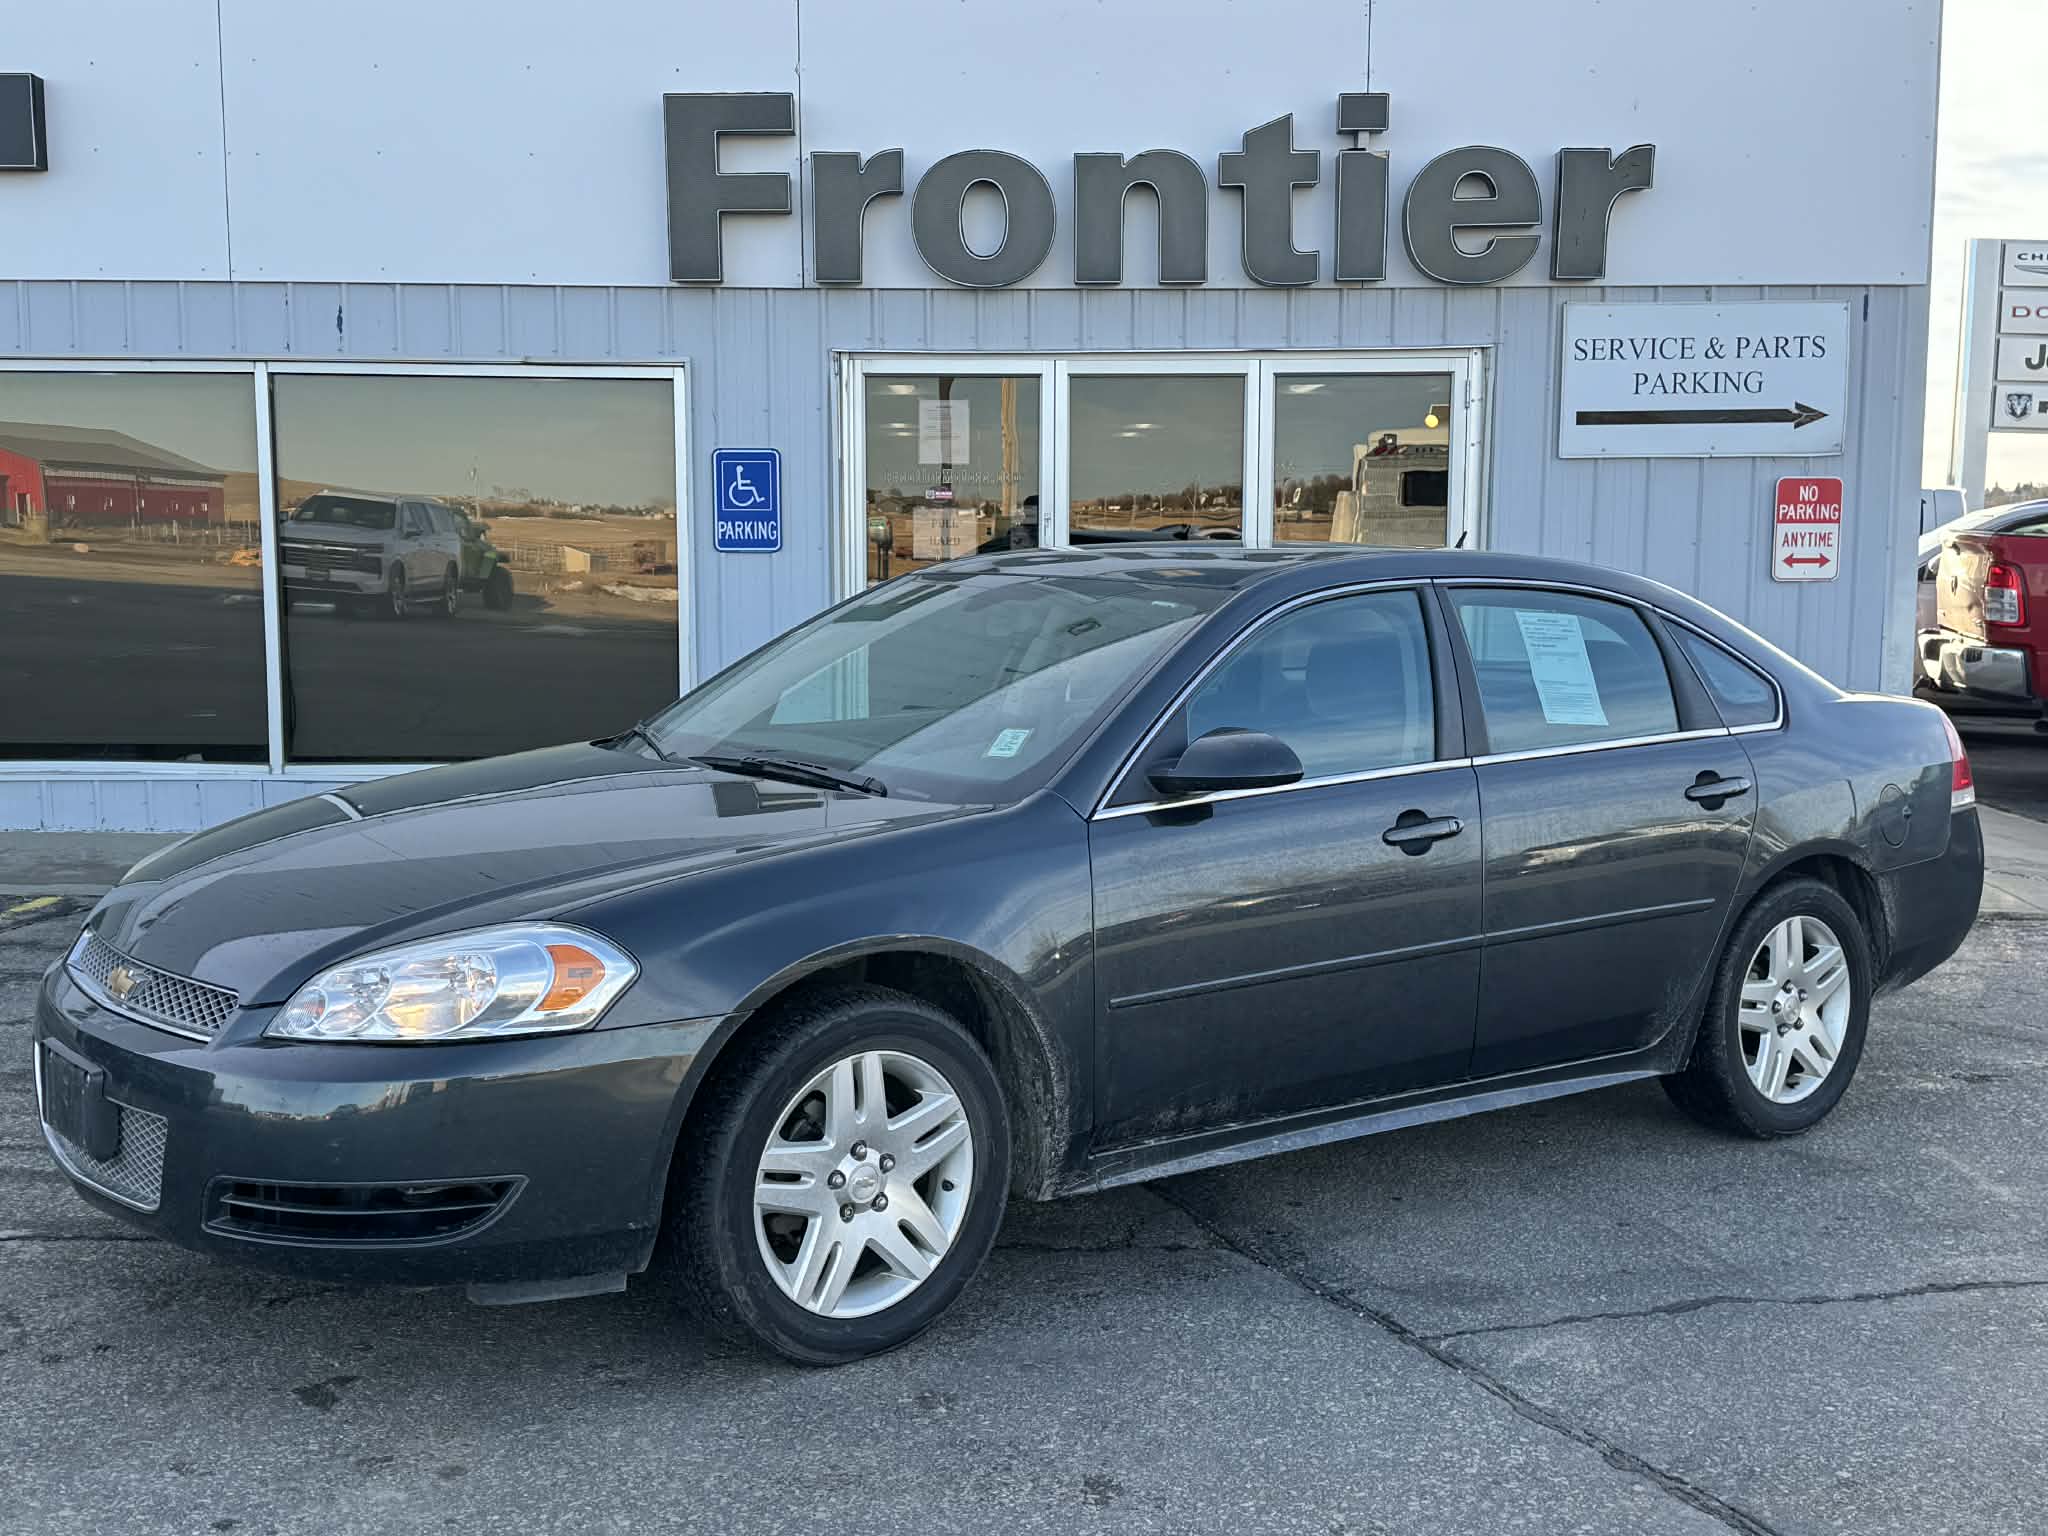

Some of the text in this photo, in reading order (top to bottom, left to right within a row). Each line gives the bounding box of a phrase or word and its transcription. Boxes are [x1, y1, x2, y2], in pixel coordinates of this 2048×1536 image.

[663, 91, 1656, 289] Frontier
[2016, 252, 2048, 261] CH
[1573, 335, 1826, 361] SERVICE & PARTS
[1631, 370, 1764, 395] PARKING
[1799, 485, 1819, 502] NO
[1779, 503, 1840, 521] PARKING
[718, 520, 777, 540] PARKING
[1782, 531, 1834, 548] ANYTIME
